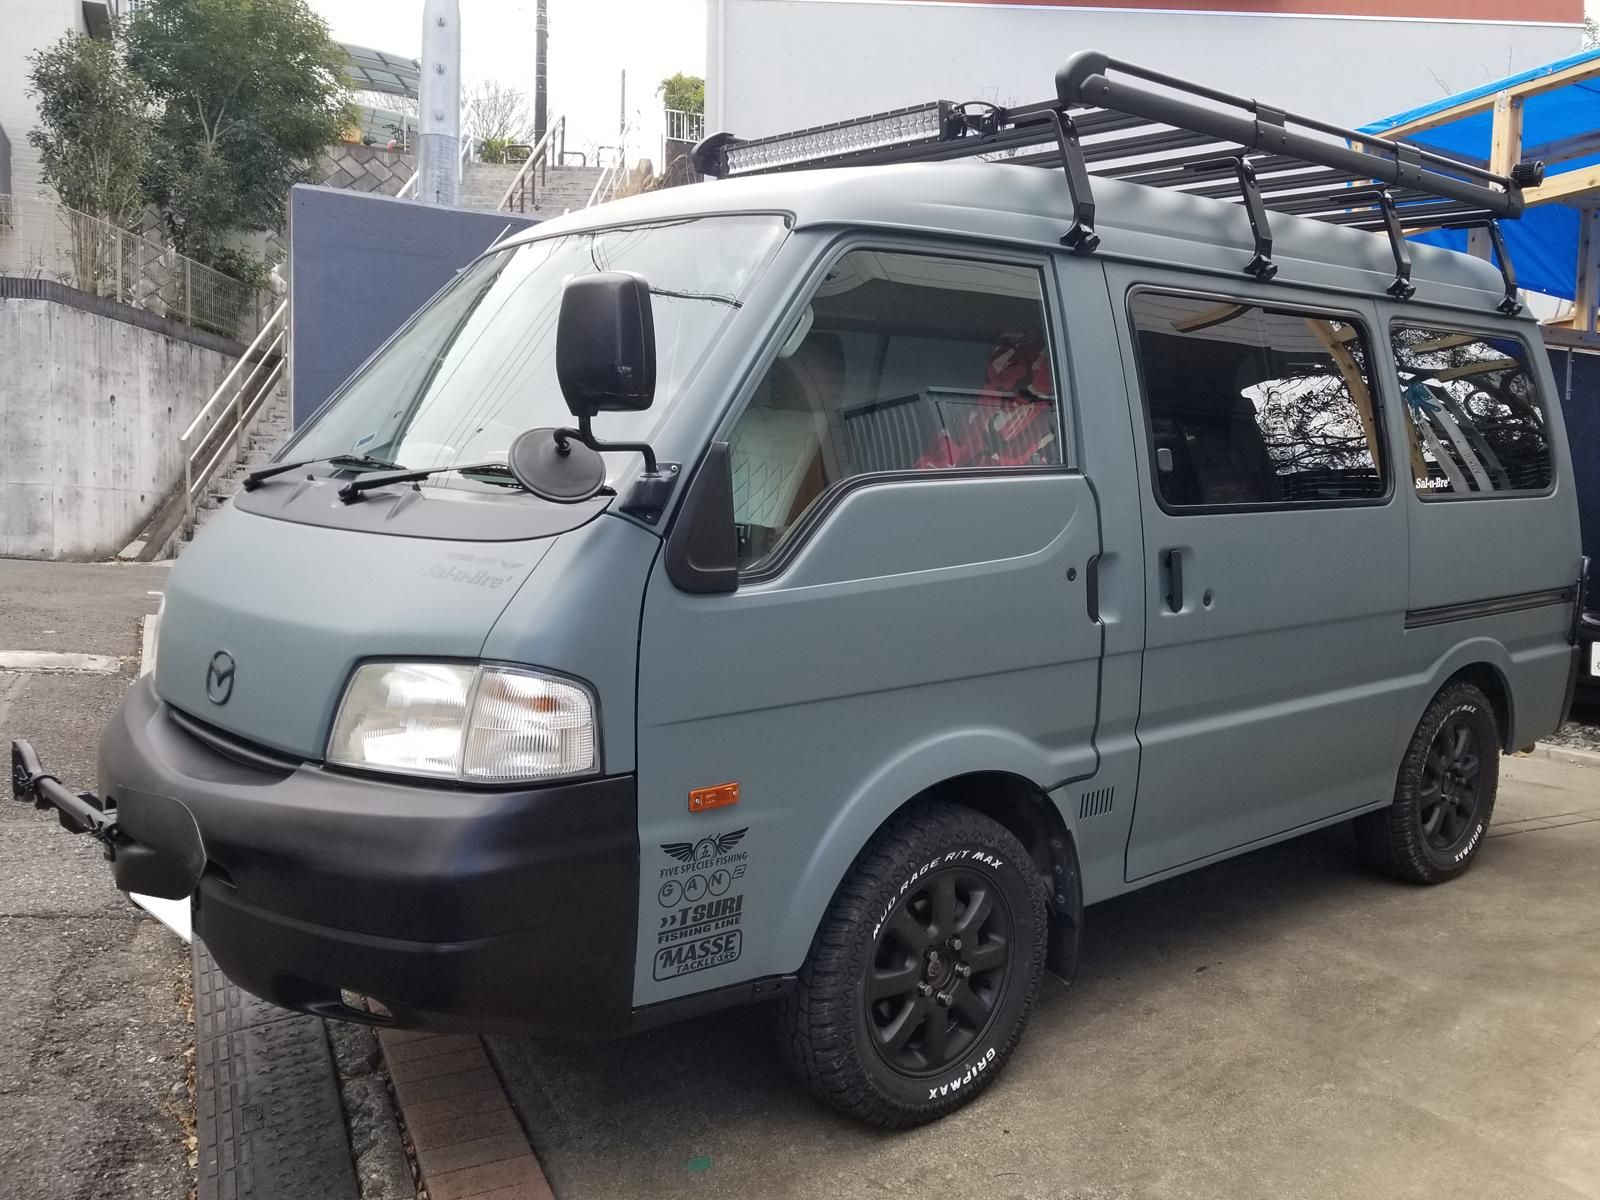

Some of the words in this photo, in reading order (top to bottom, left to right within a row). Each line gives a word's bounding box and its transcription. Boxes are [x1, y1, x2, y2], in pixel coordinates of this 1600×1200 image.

[1454, 824, 1482, 863] GRIPMAX
[660, 866, 680, 879] FIVE
[680, 858, 714, 874] SPECIES
[715, 851, 748, 866] FISHING
[873, 896, 896, 941] MUD
[900, 856, 941, 894] RAGE
[944, 850, 970, 862] R/T
[971, 851, 1003, 869] MAX
[658, 924, 711, 944] FISHING
[715, 916, 742, 930] LINE
[659, 933, 736, 969] MASSE
[928, 1047, 996, 1100] GRIPMAX
